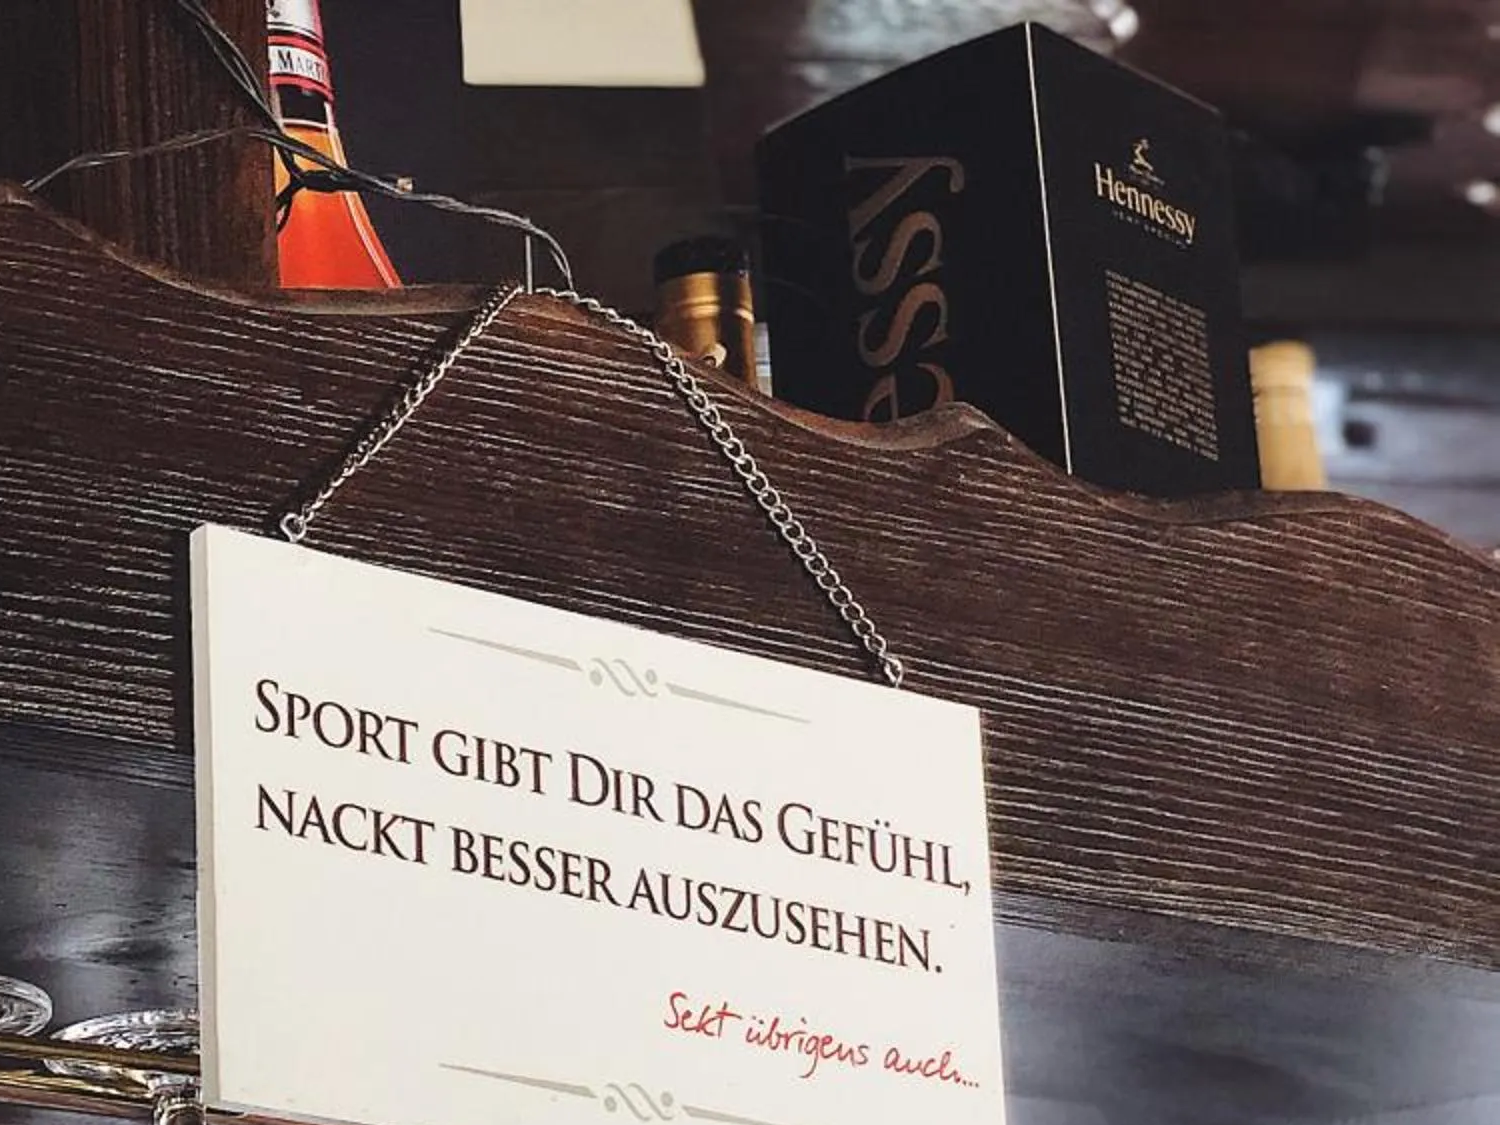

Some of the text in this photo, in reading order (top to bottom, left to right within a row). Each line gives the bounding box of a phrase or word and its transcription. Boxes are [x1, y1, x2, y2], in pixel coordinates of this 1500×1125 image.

[1093, 160, 1197, 245] Hennessy
[254, 678, 971, 897] SPORT GIBT DIR DAS GEFÜHL,
[254, 783, 943, 974] NACKT BESSER AUSZUSEHEN.
[663, 991, 743, 1038] Sekt
[745, 1015, 870, 1079] übrigens
